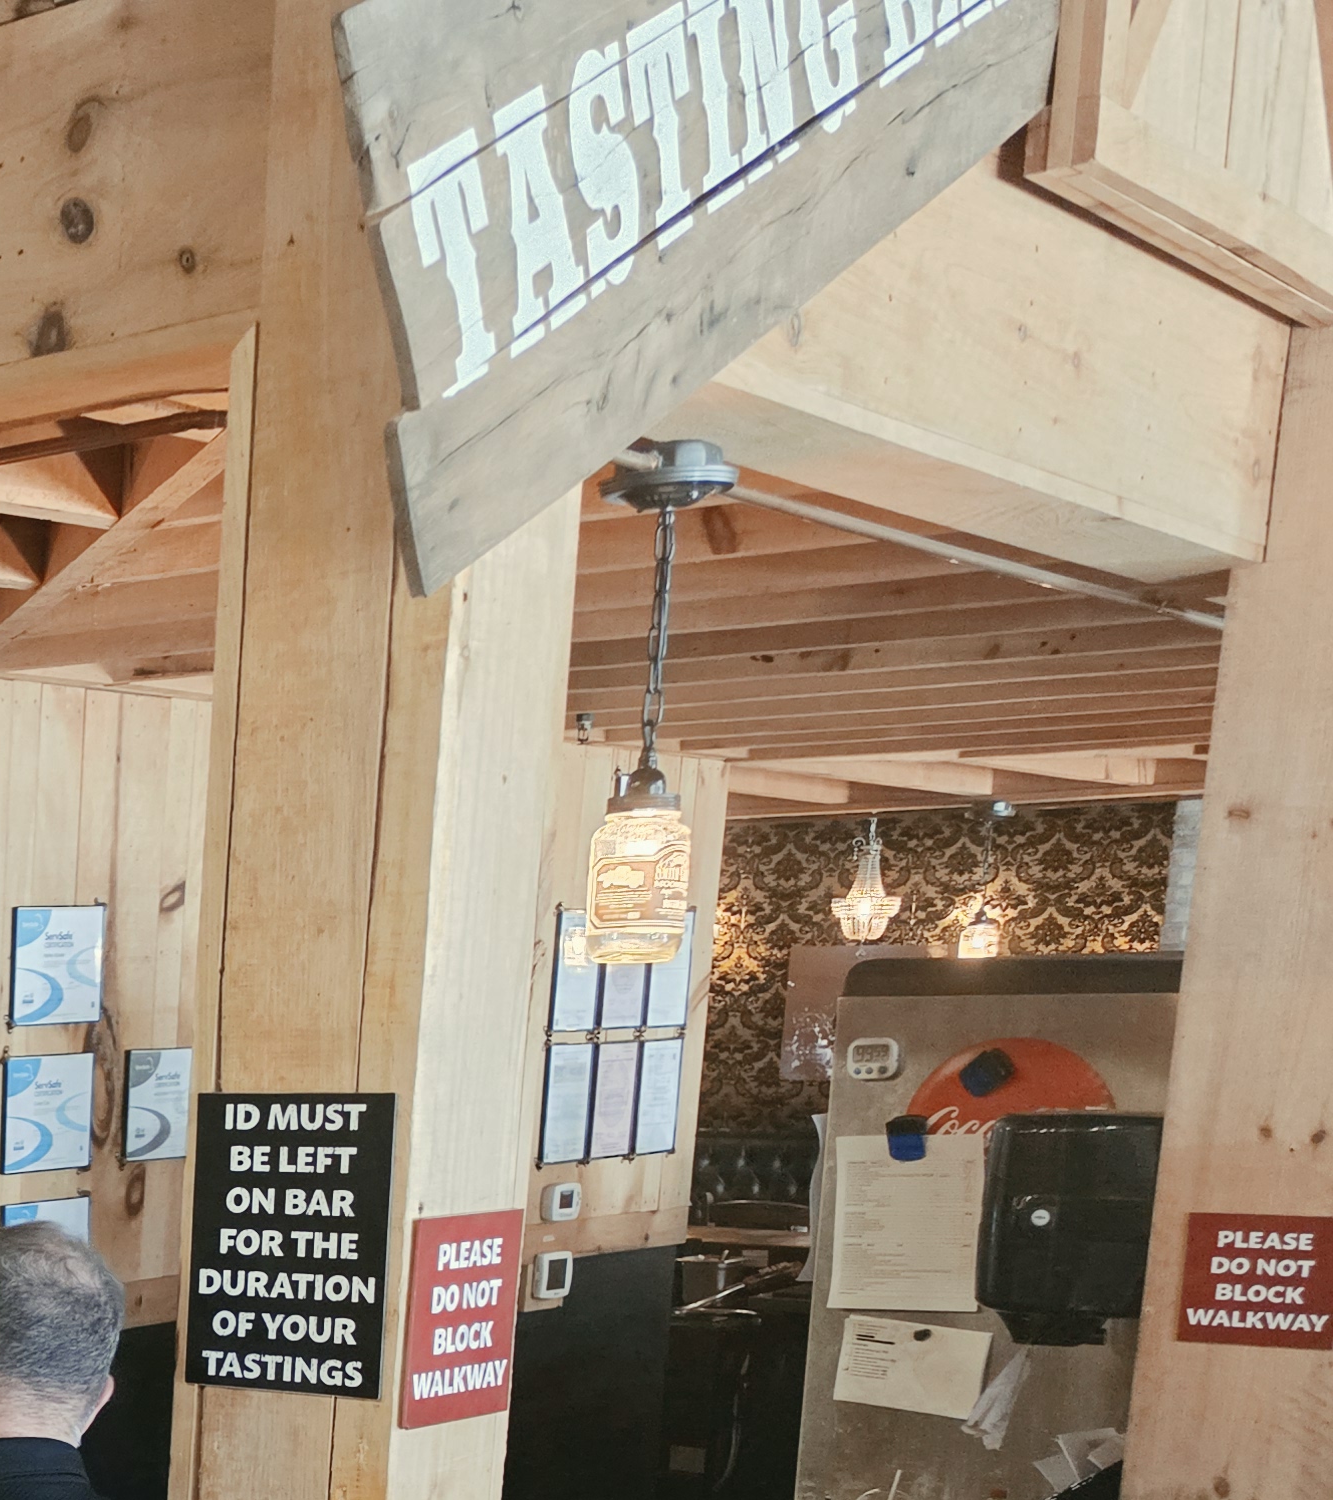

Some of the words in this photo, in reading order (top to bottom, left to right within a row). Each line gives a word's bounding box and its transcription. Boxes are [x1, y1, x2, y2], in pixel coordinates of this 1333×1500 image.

[407, 0, 859, 398] TASTING
[225, 1103, 260, 1130] ID
[267, 1103, 367, 1131] MUST
[229, 1145, 271, 1172] BE
[279, 1146, 358, 1174] LEFT
[225, 1186, 276, 1215] ON
[285, 1188, 356, 1217] BAR
[219, 1228, 284, 1257] FOR
[291, 1231, 359, 1259] THE
[437, 1237, 504, 1271] PLEASE
[1217, 1230, 1314, 1251] PLEASE
[1210, 1256, 1251, 1275] DO
[1256, 1258, 1316, 1278] NOT
[198, 1268, 376, 1304] DURATION
[430, 1284, 460, 1314] DO
[462, 1278, 503, 1310] NOT
[1214, 1283, 1306, 1305] BLOCK
[212, 1310, 256, 1337] OF
[261, 1313, 357, 1345] YOUR
[1186, 1308, 1330, 1333] WALKWAY
[432, 1321, 494, 1355] BLOCK
[201, 1350, 363, 1388] TASTINGS
[412, 1359, 508, 1400] WALKWAY
